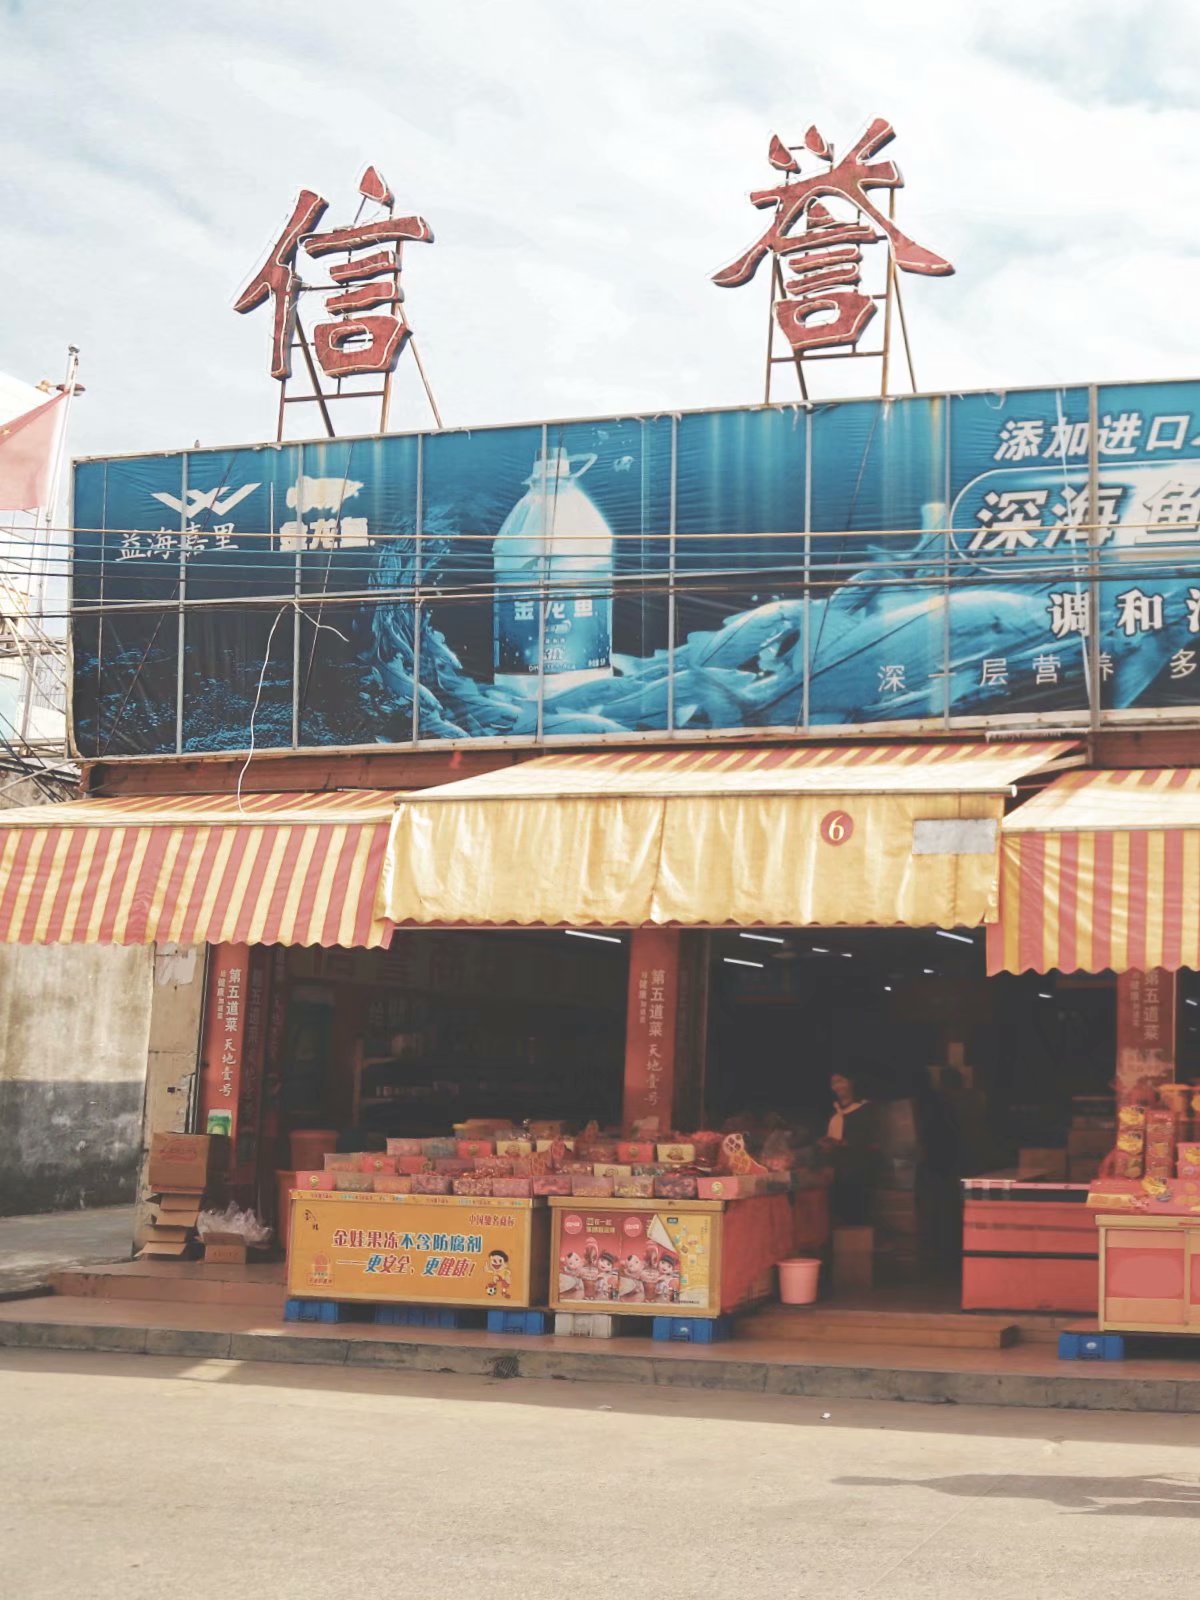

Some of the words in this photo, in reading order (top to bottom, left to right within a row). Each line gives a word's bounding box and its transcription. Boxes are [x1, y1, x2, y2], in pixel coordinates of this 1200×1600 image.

[993, 413, 1190, 461] 添加进口
[115, 520, 239, 561] 益海嘉里
[828, 814, 845, 841] 6
[225, 967, 242, 1033] 第五道菜
[648, 969, 666, 1037] 第五道菜
[218, 1038, 236, 1098] 天地壹号
[332, 1229, 482, 1254] 金娃果冻不含防腐剂
